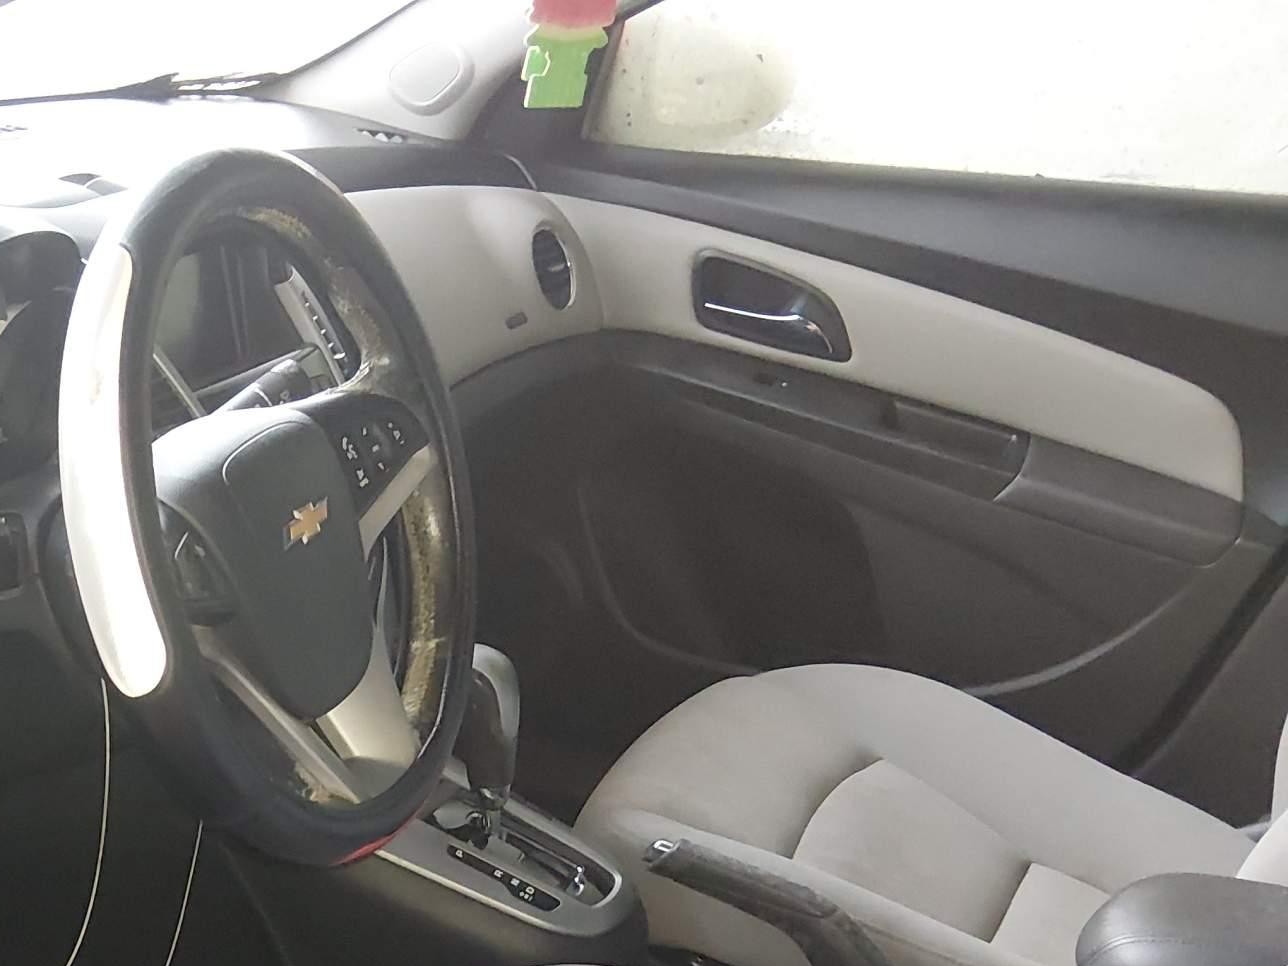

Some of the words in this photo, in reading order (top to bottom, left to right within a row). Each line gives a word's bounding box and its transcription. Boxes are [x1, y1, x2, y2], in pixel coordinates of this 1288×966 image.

[455, 849, 464, 858] P
[494, 869, 504, 878] R
[525, 886, 535, 895] D
